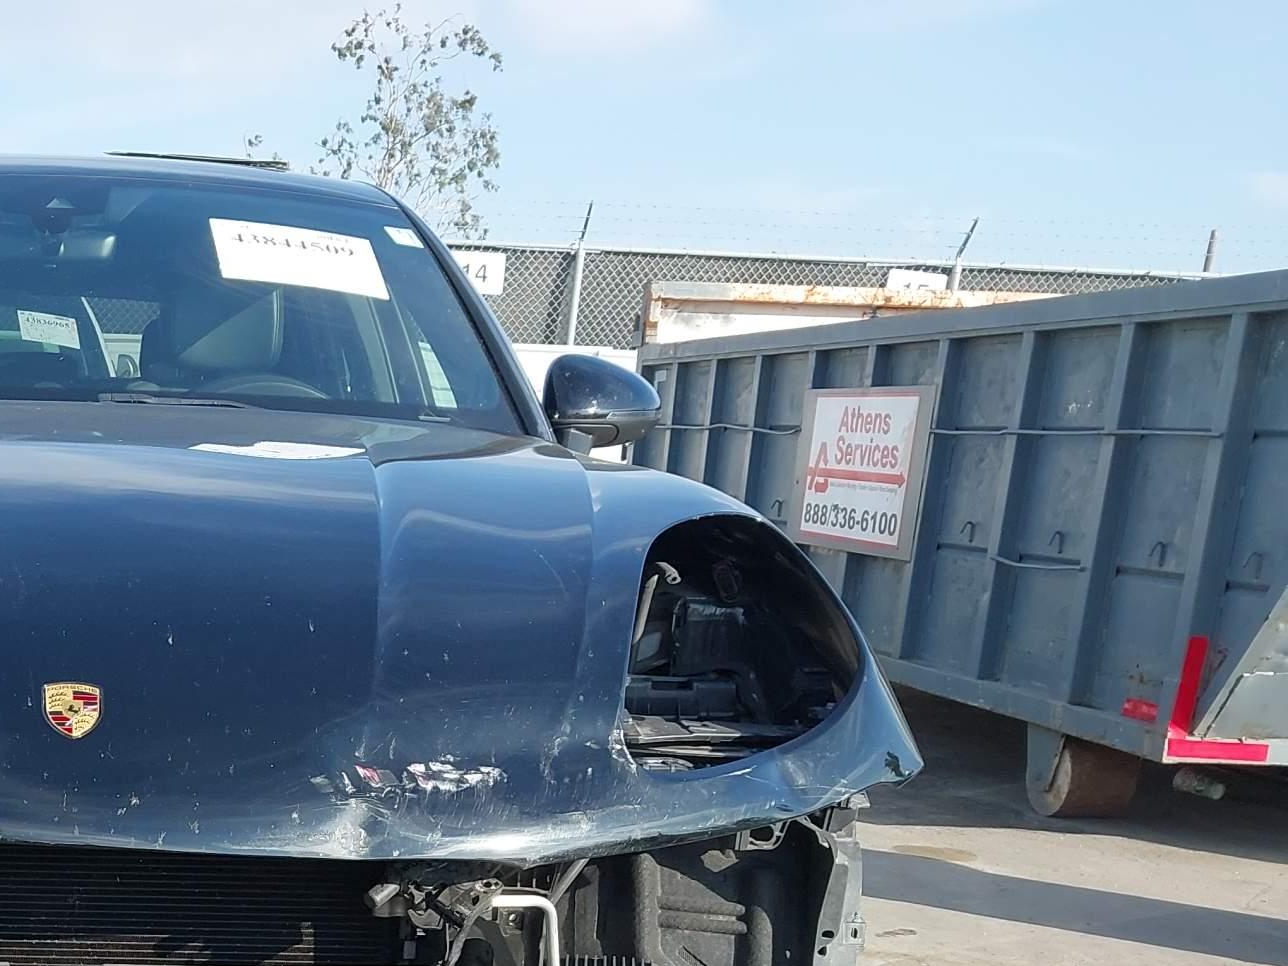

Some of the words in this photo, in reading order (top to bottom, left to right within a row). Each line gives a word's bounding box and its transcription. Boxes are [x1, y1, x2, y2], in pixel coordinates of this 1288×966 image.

[838, 405, 892, 435] Athens
[834, 435, 899, 469] Services
[803, 502, 898, 537] 888/336-6100
